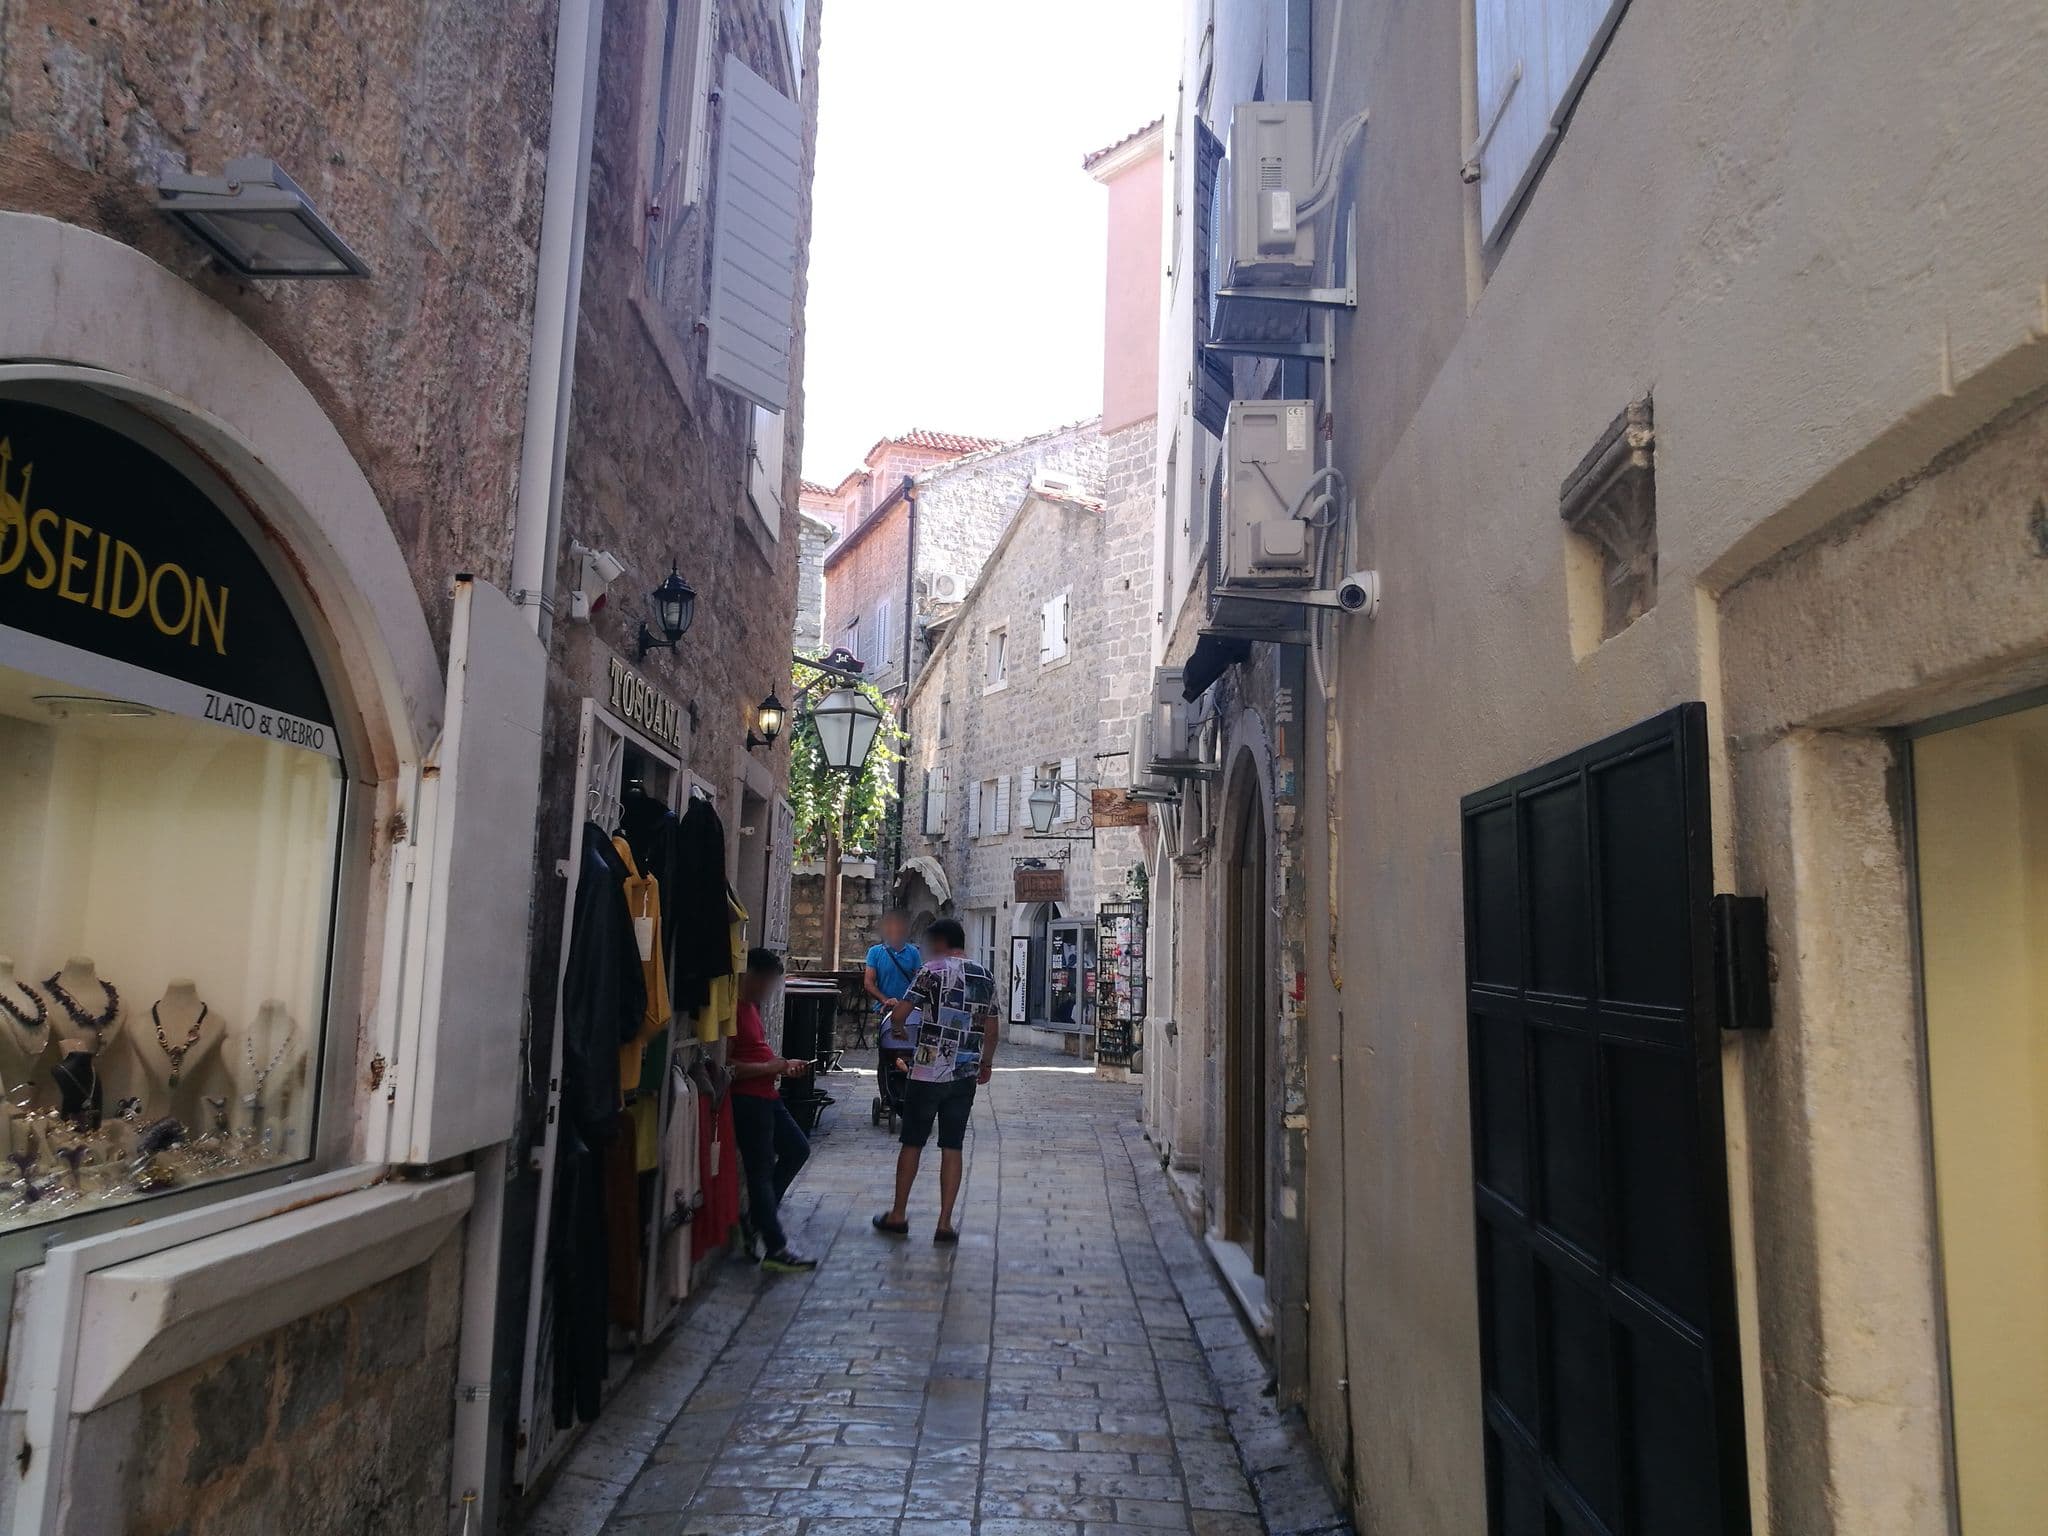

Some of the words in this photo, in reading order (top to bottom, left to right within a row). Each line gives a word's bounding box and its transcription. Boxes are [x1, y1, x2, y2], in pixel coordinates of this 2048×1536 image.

[204, 693, 256, 730] ZLATO
[277, 716, 324, 750] SREBRO
[610, 656, 682, 749] TOSCANA
